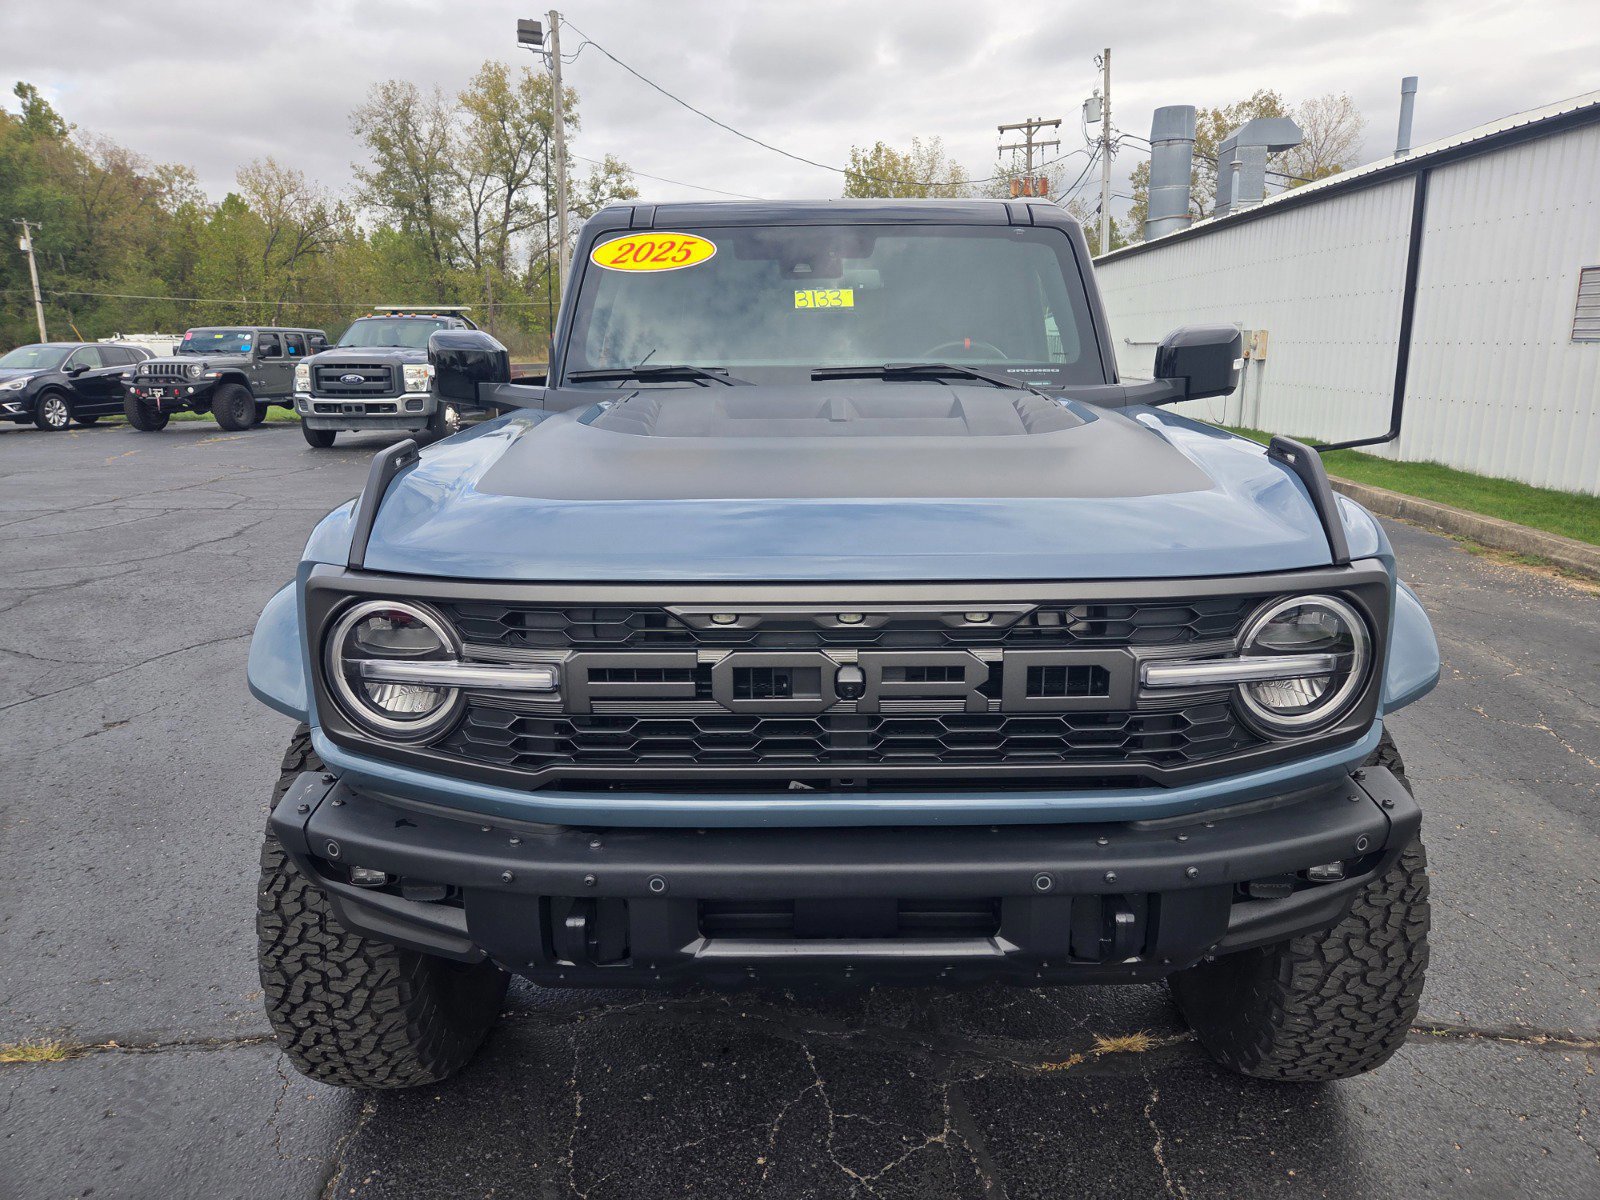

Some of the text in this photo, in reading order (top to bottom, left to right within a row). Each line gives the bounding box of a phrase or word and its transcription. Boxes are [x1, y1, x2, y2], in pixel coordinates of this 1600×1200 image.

[610, 240, 697, 264] 2025
[796, 290, 842, 307] 3133
[563, 650, 1136, 714] FORD
